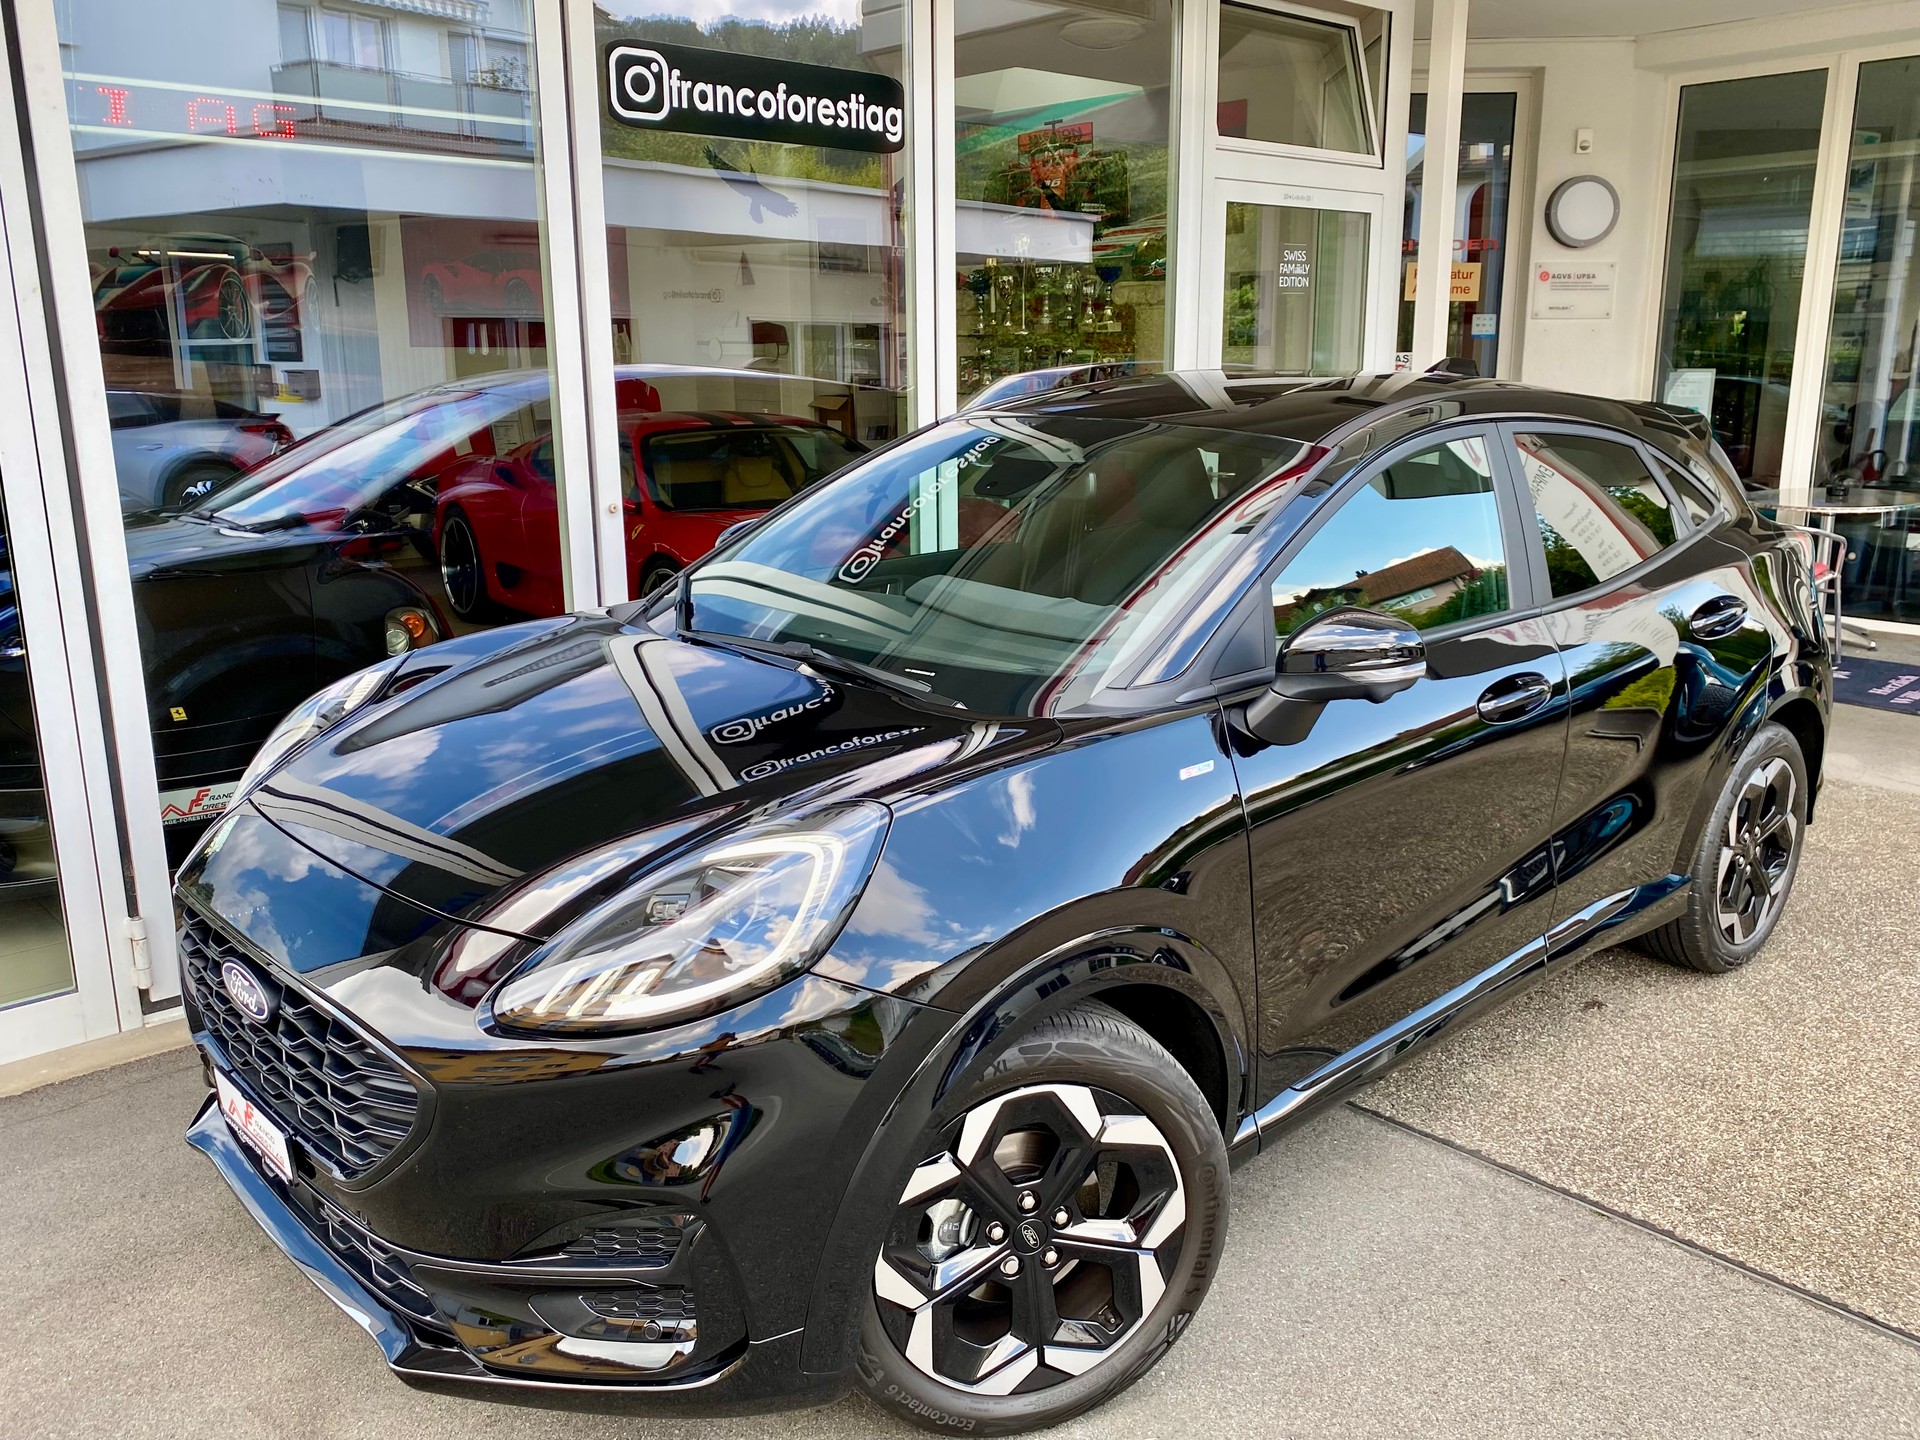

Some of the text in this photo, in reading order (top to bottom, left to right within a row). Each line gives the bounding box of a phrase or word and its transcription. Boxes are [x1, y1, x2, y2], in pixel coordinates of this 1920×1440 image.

[669, 68, 903, 143] francoforestiag
[1283, 250, 1307, 262] SWISS
[1279, 276, 1309, 288] EDITION
[230, 968, 259, 1014] Ford
[896, 1390, 977, 1432] EcoContact
